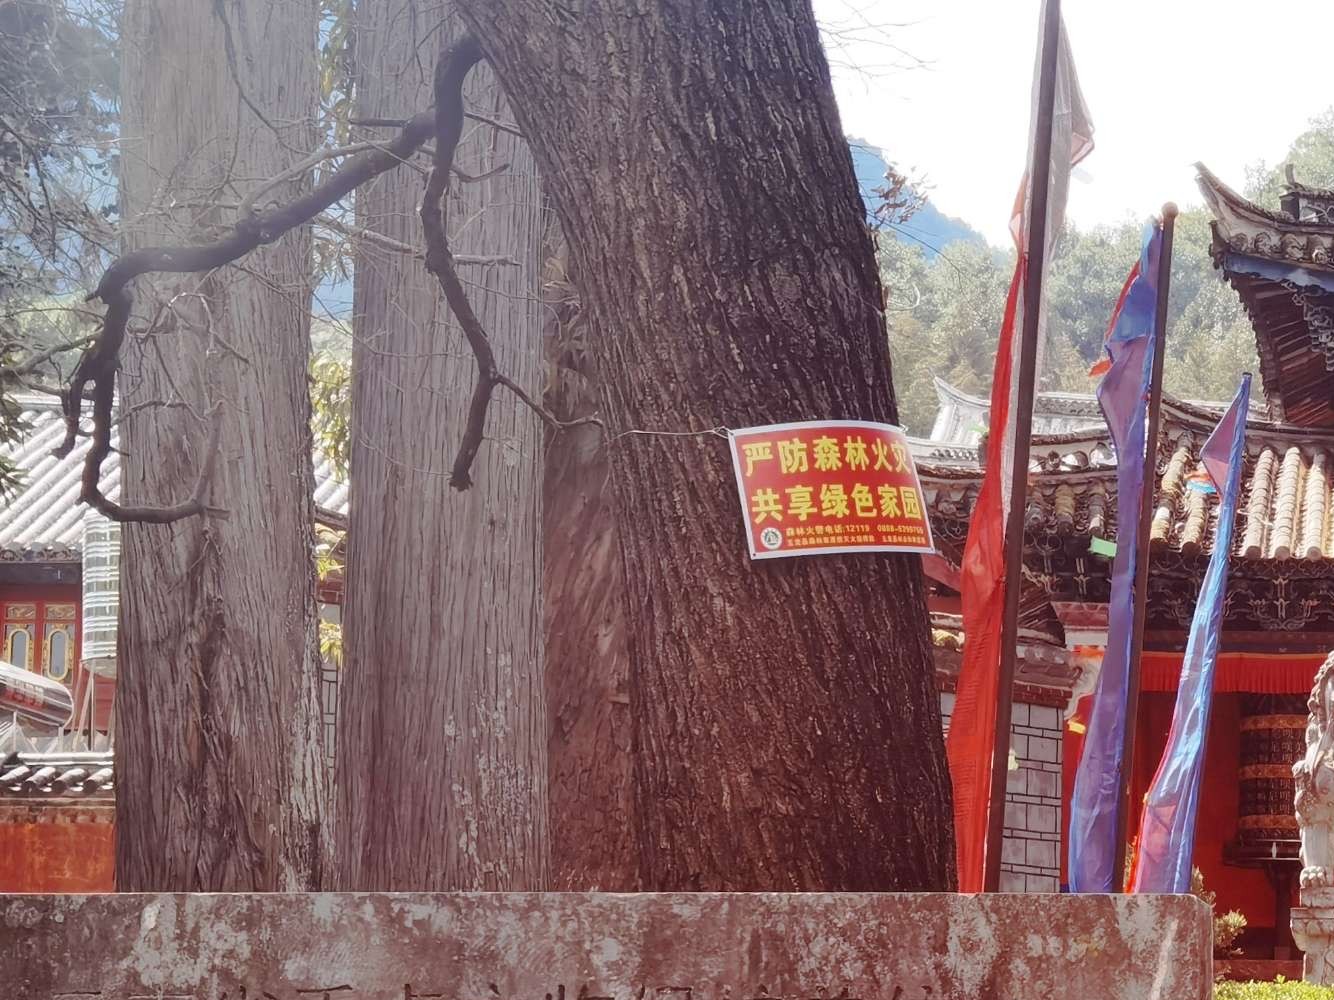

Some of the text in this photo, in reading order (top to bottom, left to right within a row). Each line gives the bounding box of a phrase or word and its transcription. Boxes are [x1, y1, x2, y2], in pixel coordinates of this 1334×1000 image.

[741, 435, 911, 477] 严防森林火灾
[751, 483, 922, 524] 共享绿色家园
